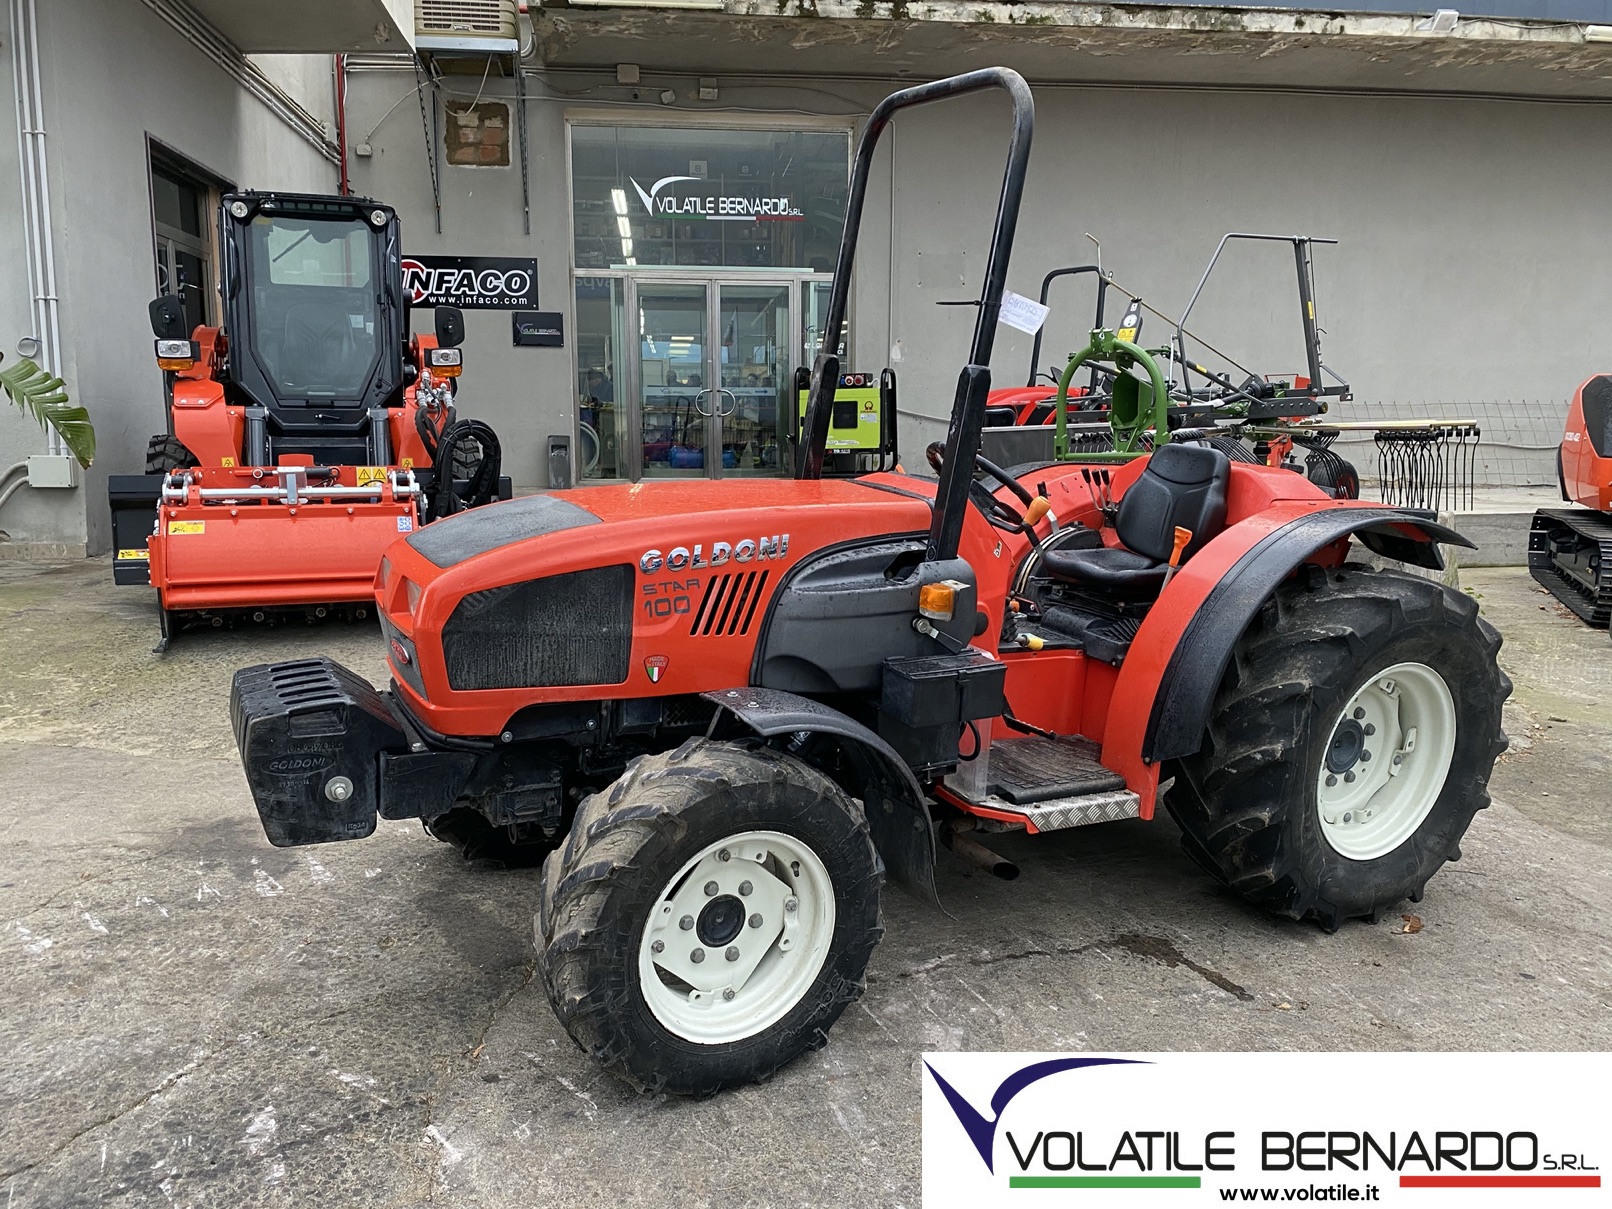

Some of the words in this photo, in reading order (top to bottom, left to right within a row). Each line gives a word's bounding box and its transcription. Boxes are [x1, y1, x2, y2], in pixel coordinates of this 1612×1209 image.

[656, 197, 714, 214] VOLATILE
[718, 197, 789, 215] BERNARDO
[428, 295, 528, 305] www.infaco.com
[639, 534, 790, 575] GOLDONI
[642, 578, 700, 595] STAR
[643, 595, 691, 618] 100
[269, 757, 326, 771] GOLDONI
